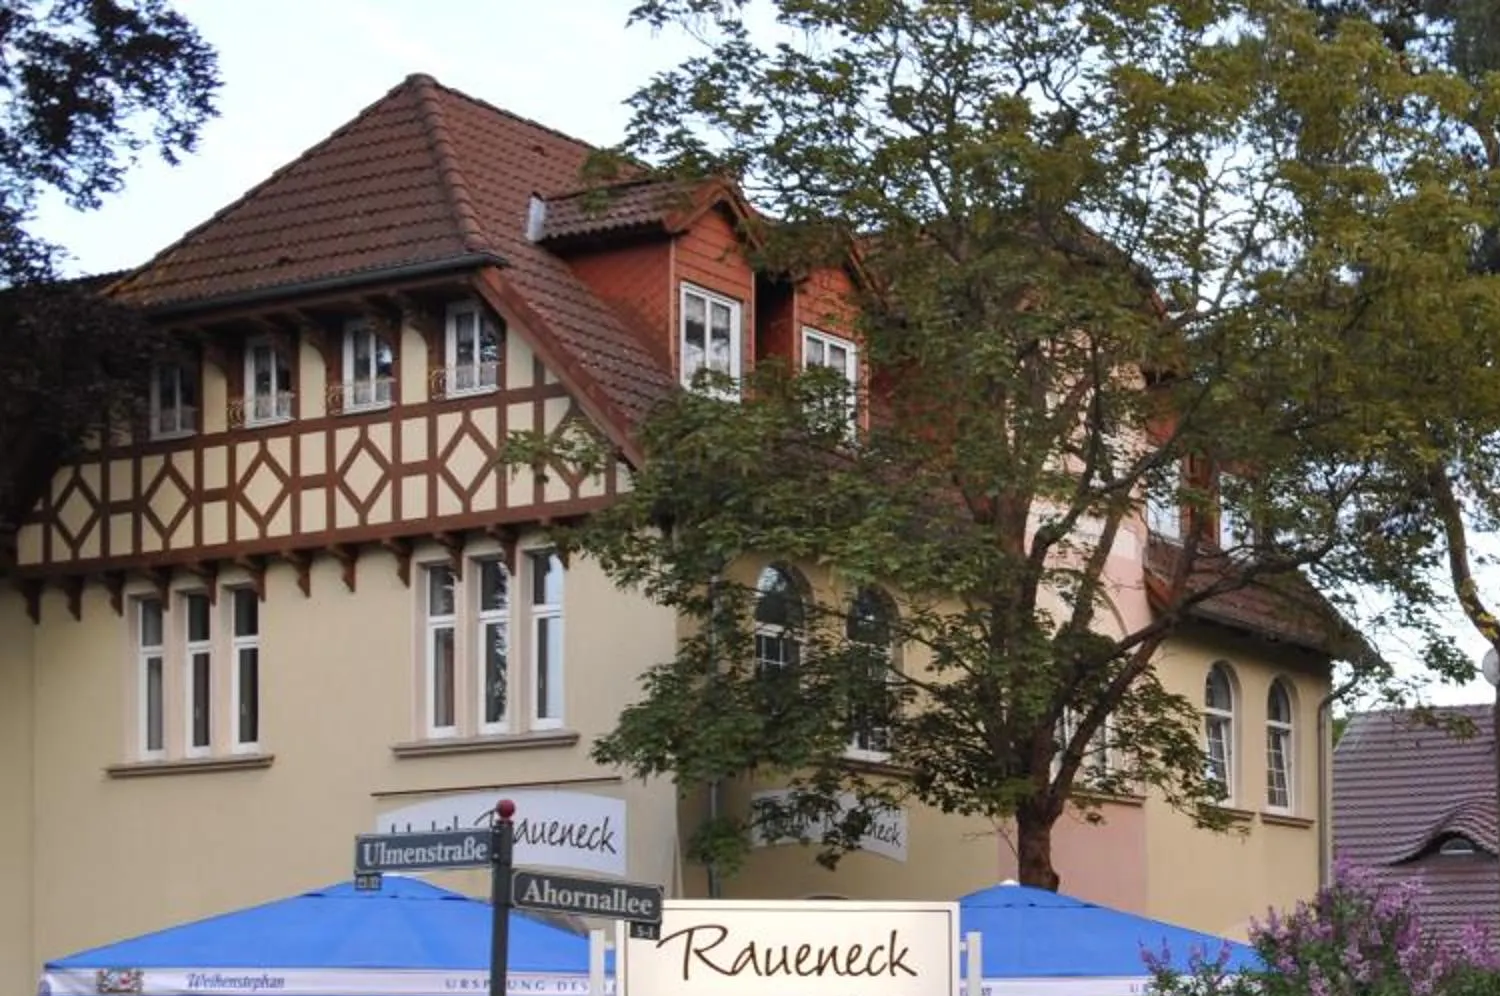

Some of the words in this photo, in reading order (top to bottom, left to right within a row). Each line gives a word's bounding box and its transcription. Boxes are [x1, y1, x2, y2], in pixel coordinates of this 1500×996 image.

[363, 835, 488, 866] Ulmenstraße
[523, 878, 653, 915] Ahornallee
[656, 924, 918, 981] Raueneck
[186, 970, 286, 992] Weihenstephan
[445, 977, 545, 992] URSPUNG
